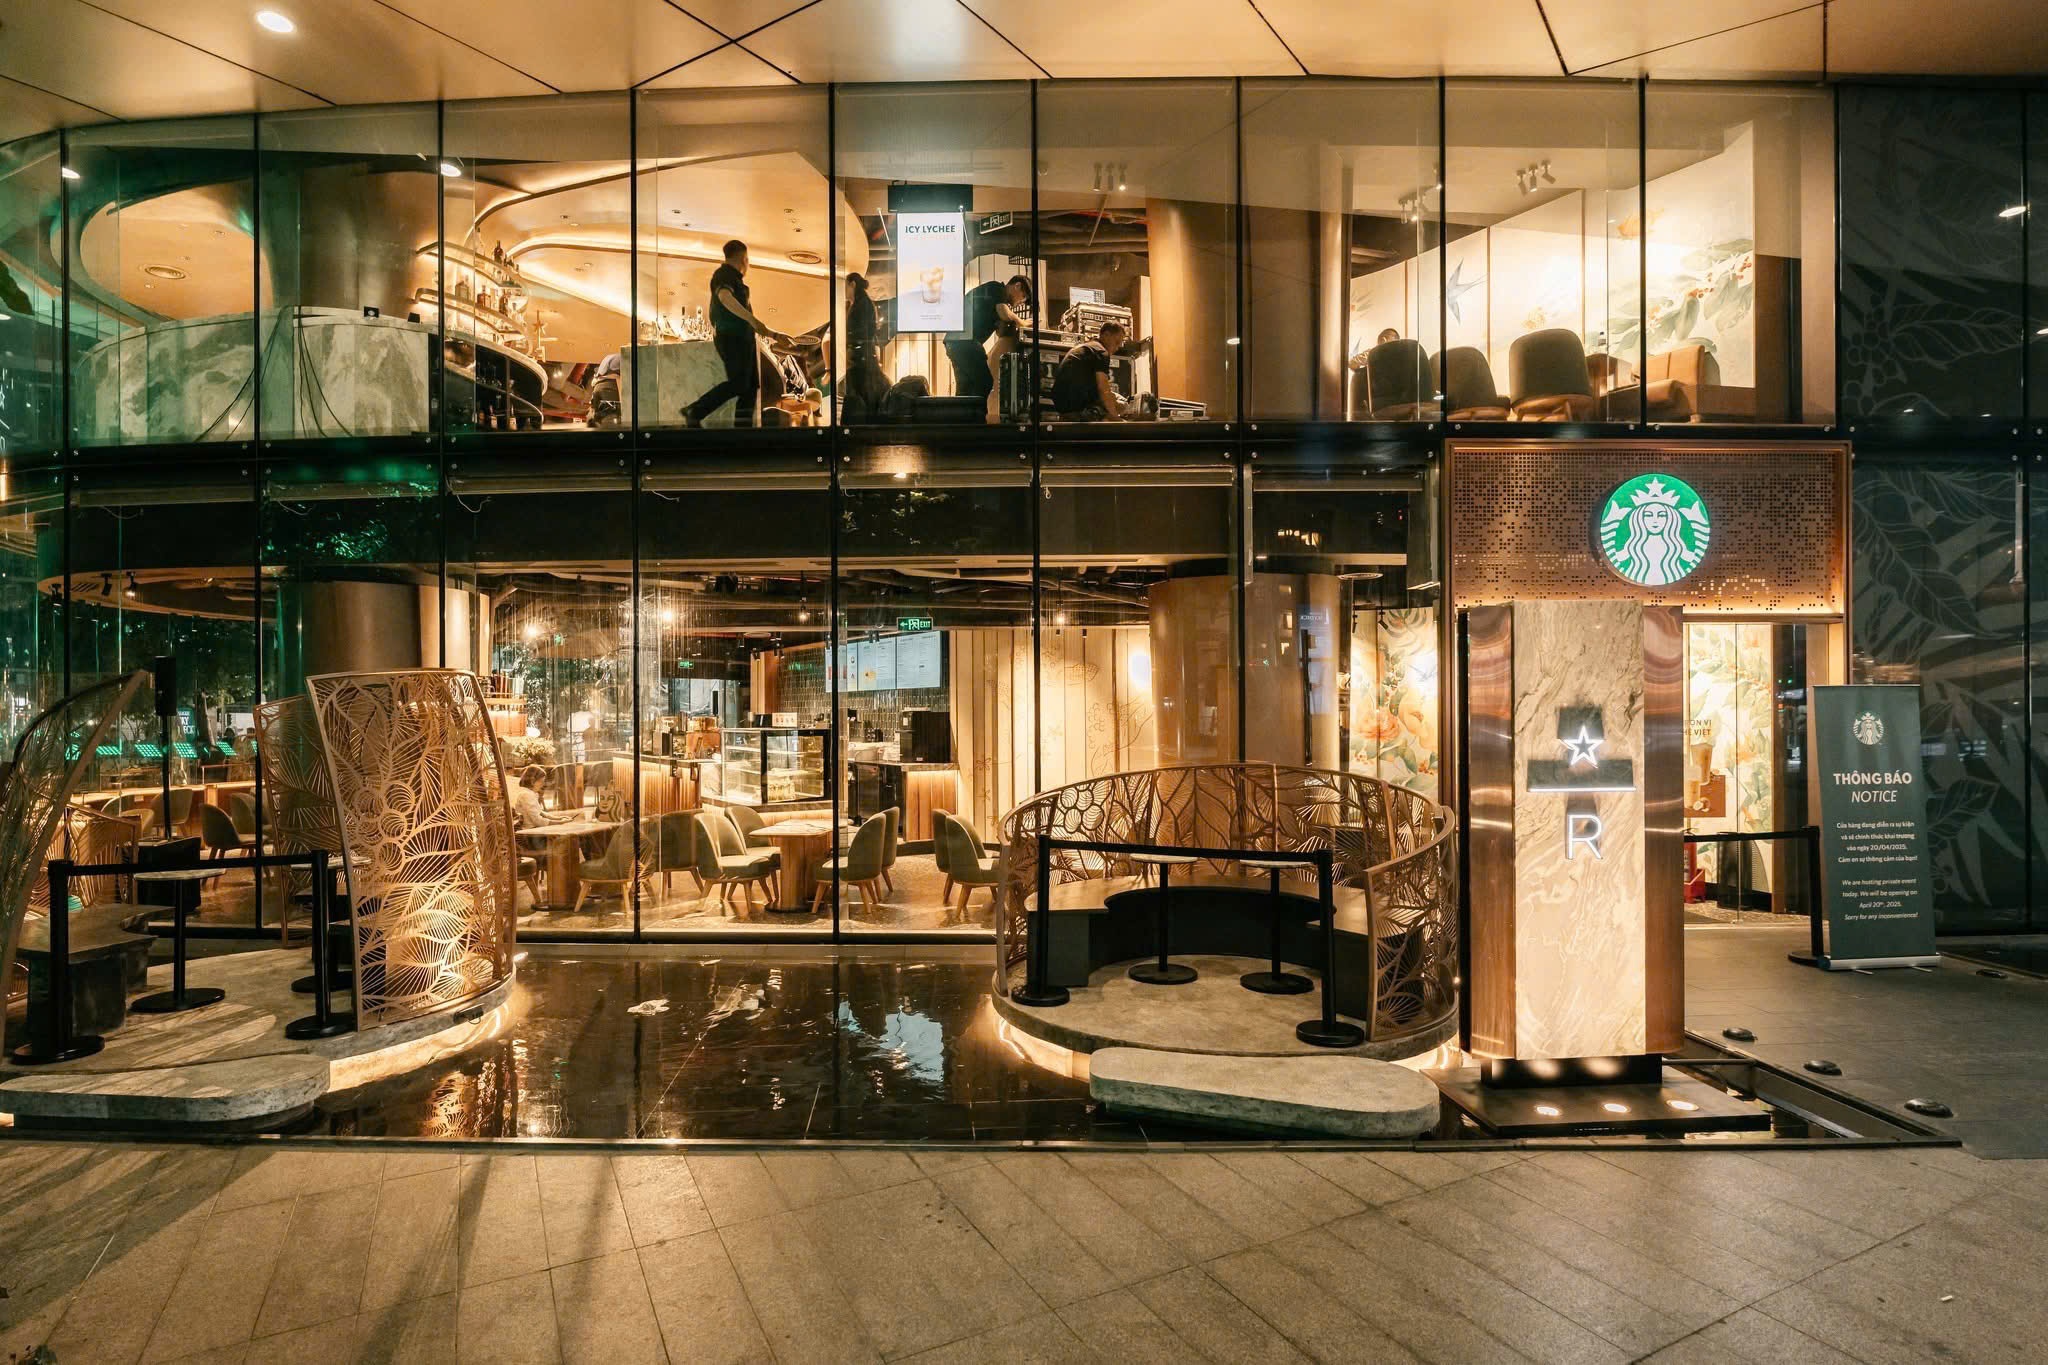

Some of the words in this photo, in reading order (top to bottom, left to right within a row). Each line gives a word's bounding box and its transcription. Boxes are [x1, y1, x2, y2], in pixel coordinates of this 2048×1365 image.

[1833, 770, 1882, 784] THÔNG
[1884, 770, 1912, 784] BÁO
[1852, 790, 1898, 803] NOTICE
[1568, 814, 1602, 859] R
